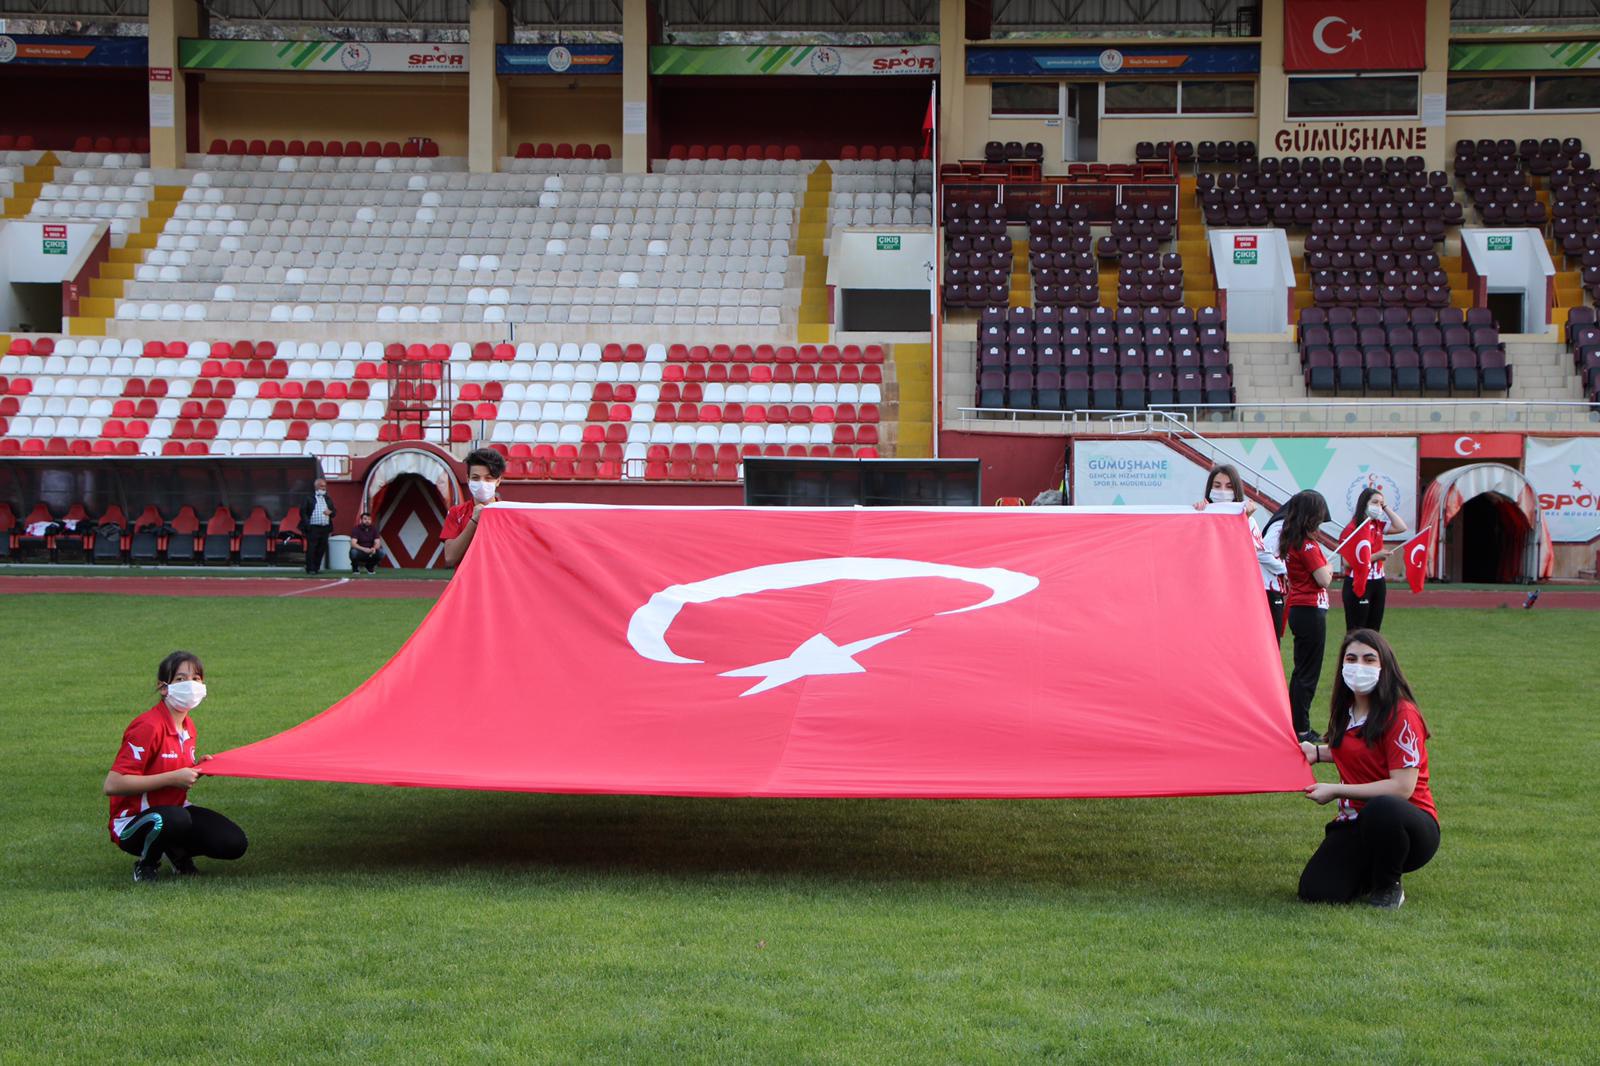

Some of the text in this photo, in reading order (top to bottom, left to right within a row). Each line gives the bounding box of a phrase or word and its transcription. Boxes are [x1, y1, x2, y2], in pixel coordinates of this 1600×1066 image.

[408, 54, 464, 65] SPOR
[872, 57, 935, 70] SPOR
[1275, 122, 1427, 153] GÜMÜŞHANE
[1088, 458, 1168, 472] GÜMÜŞHANE
[1537, 494, 1600, 511] SPO
